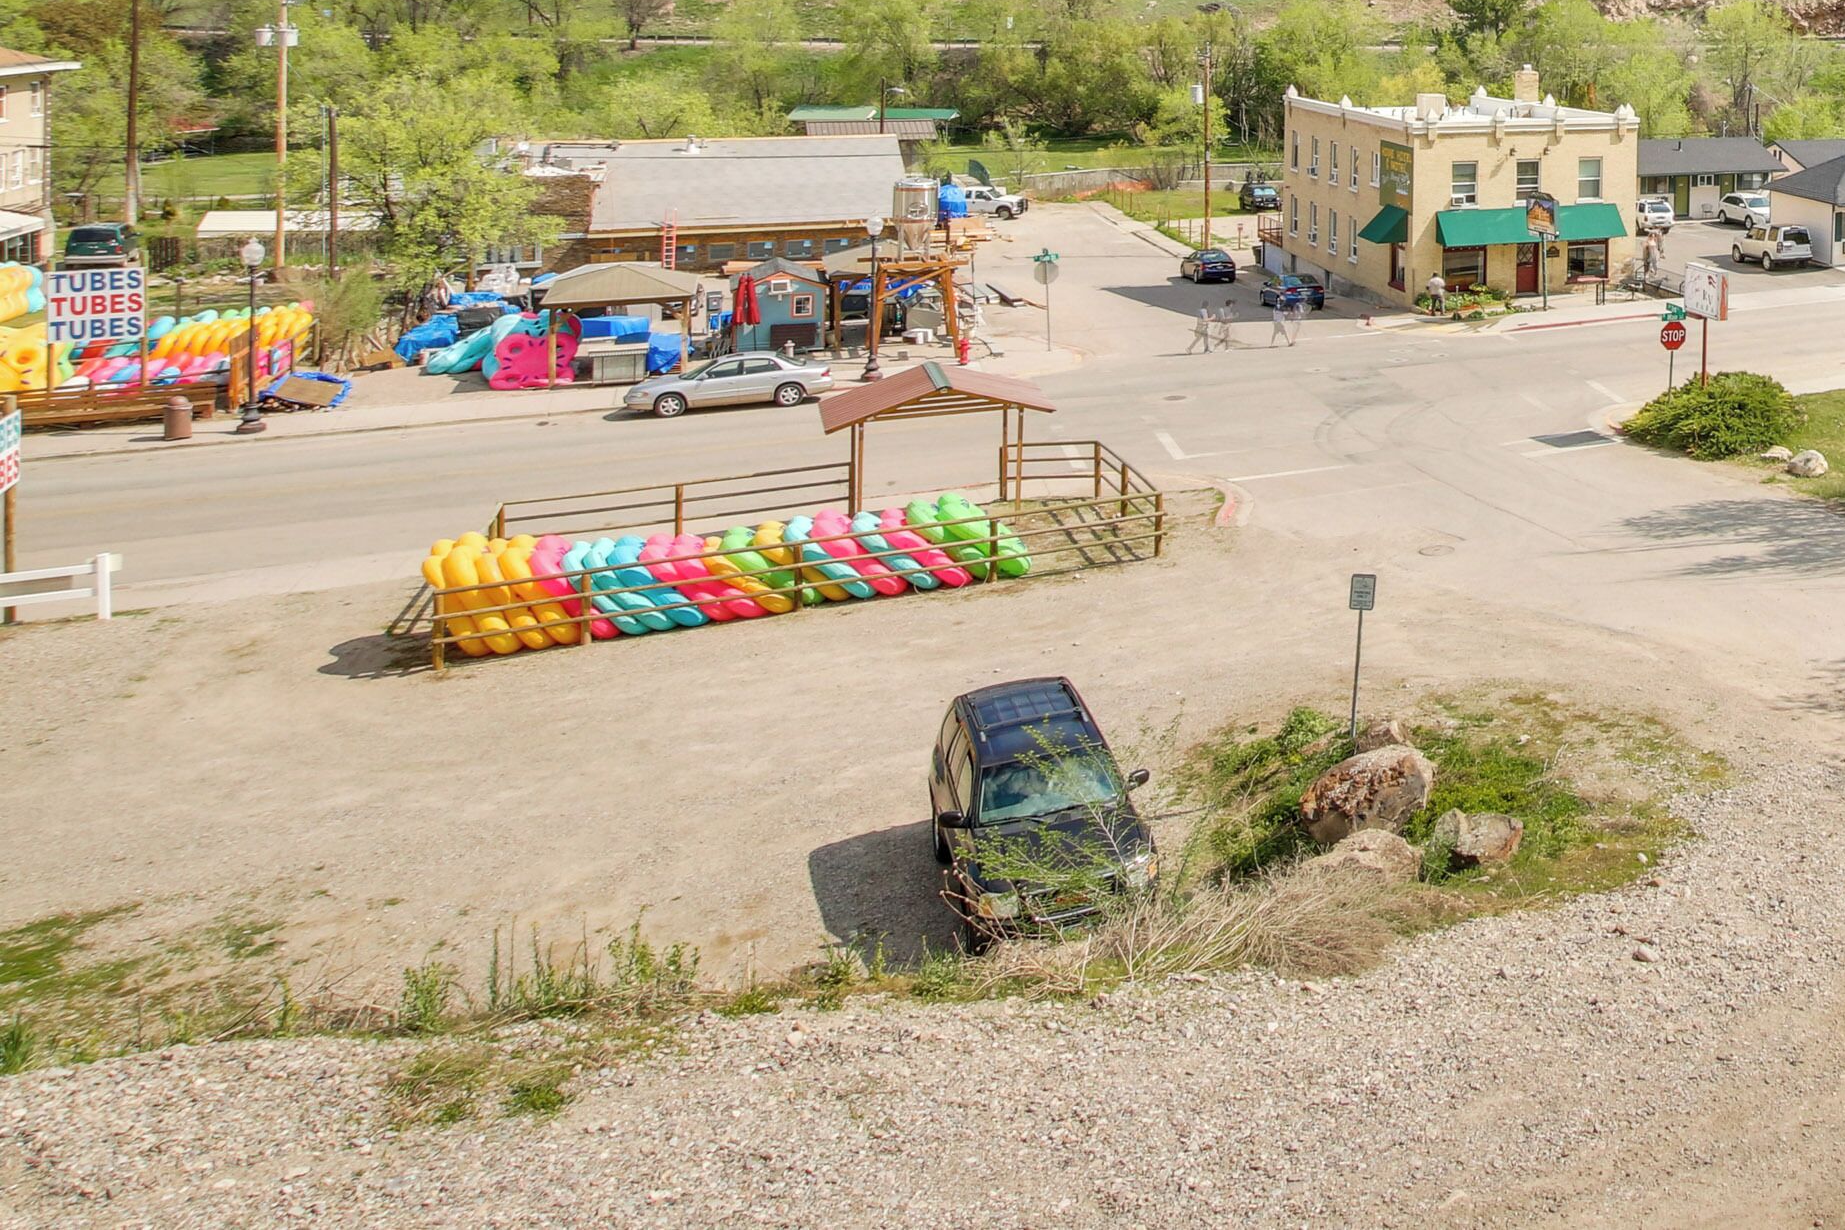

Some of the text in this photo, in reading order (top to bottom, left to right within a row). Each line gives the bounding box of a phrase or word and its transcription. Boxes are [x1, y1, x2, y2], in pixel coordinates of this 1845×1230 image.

[50, 270, 142, 293] TUBES
[50, 293, 143, 317] TUBES
[50, 317, 142, 341] TUBES
[1661, 330, 1685, 343] STOP
